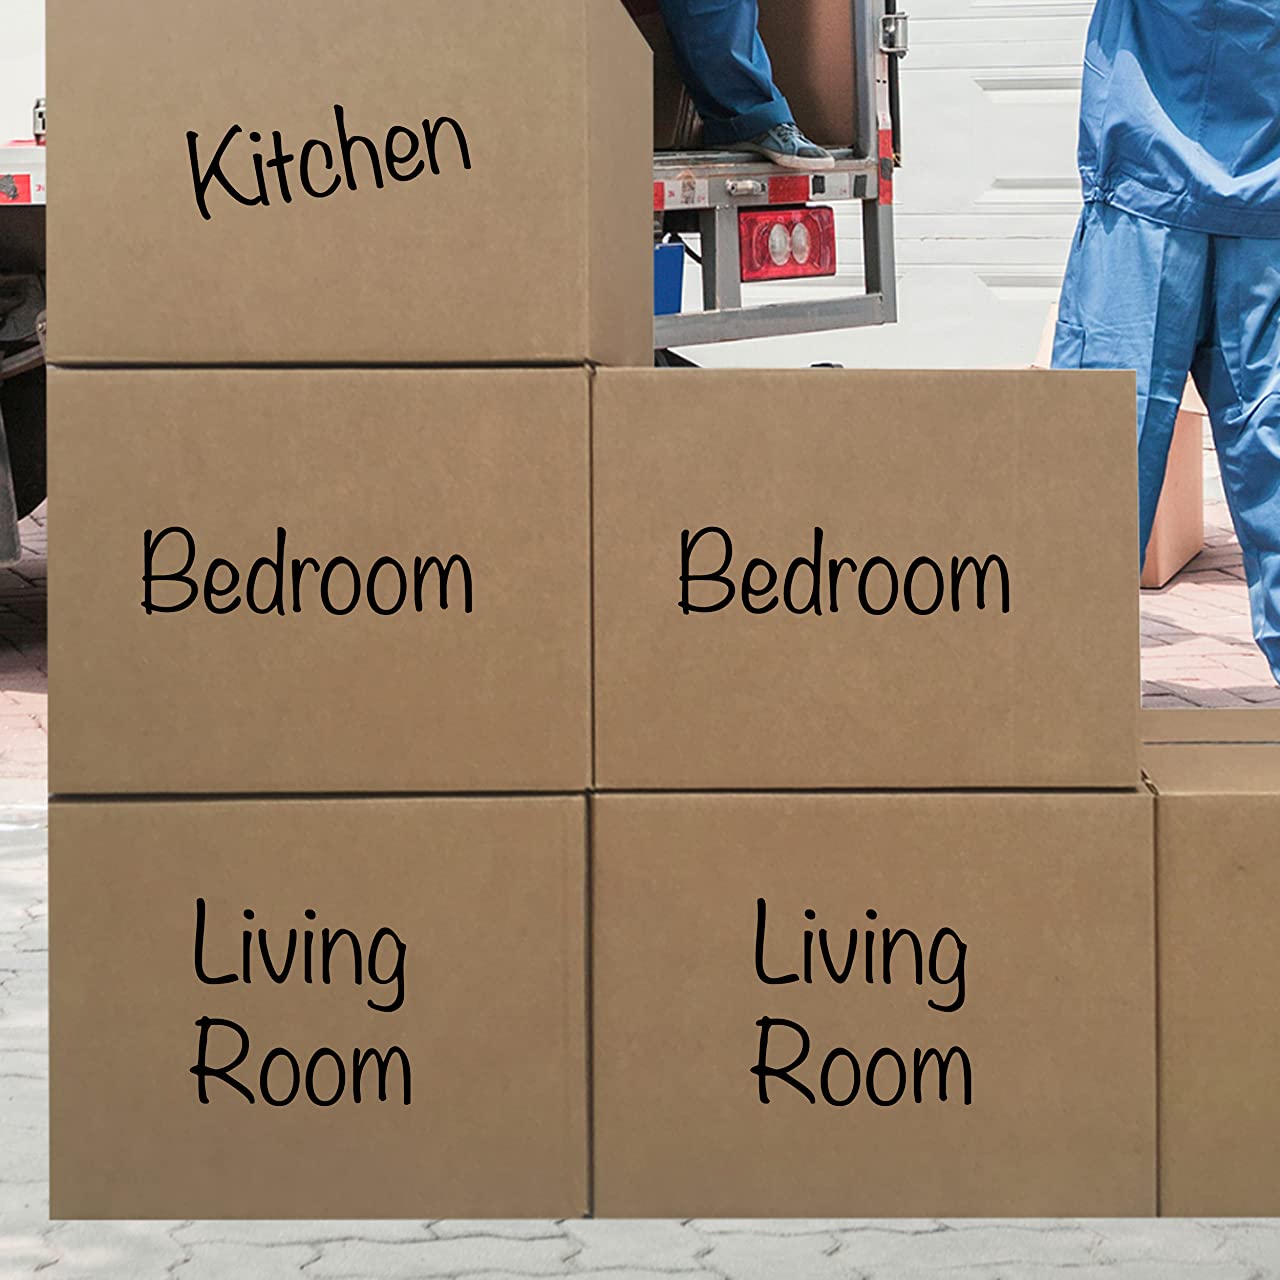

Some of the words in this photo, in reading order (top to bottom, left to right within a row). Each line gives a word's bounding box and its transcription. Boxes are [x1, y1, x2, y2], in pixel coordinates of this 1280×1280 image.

[187, 105, 471, 220] Kitchen
[141, 527, 472, 616] Bedroom
[678, 527, 1009, 616] Bedroom
[195, 898, 406, 1012] Living
[756, 898, 967, 1012] Living
[190, 1016, 410, 1106] Room
[750, 1016, 971, 1106] Room
